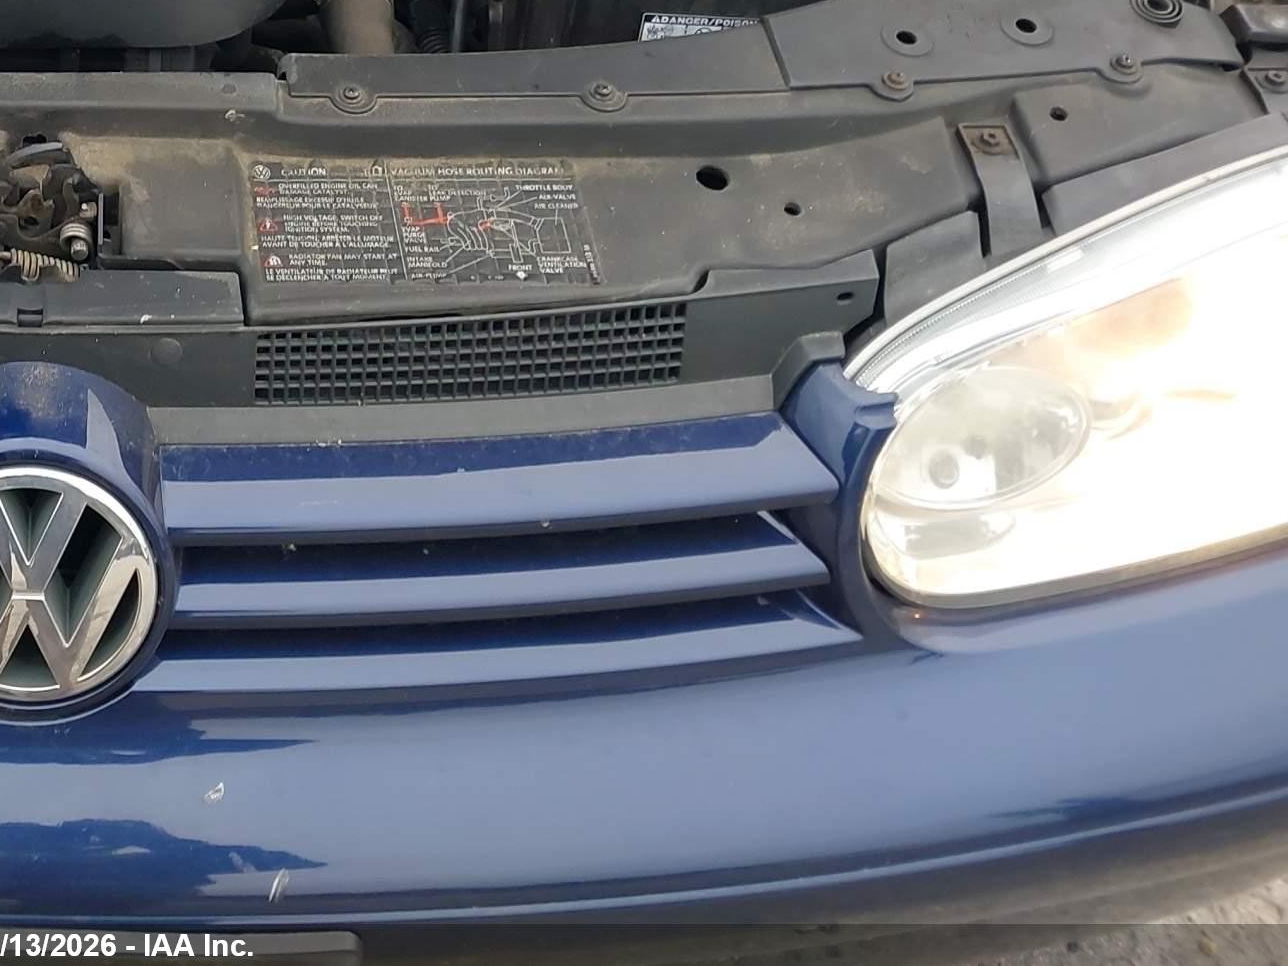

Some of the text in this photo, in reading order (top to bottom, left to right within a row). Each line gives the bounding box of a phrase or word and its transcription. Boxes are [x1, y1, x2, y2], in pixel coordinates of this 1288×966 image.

[660, 16, 758, 27] DANGER/POISO
[281, 167, 327, 176] CAUTION
[437, 167, 464, 175] HOSE
[465, 167, 513, 175] ROUTING
